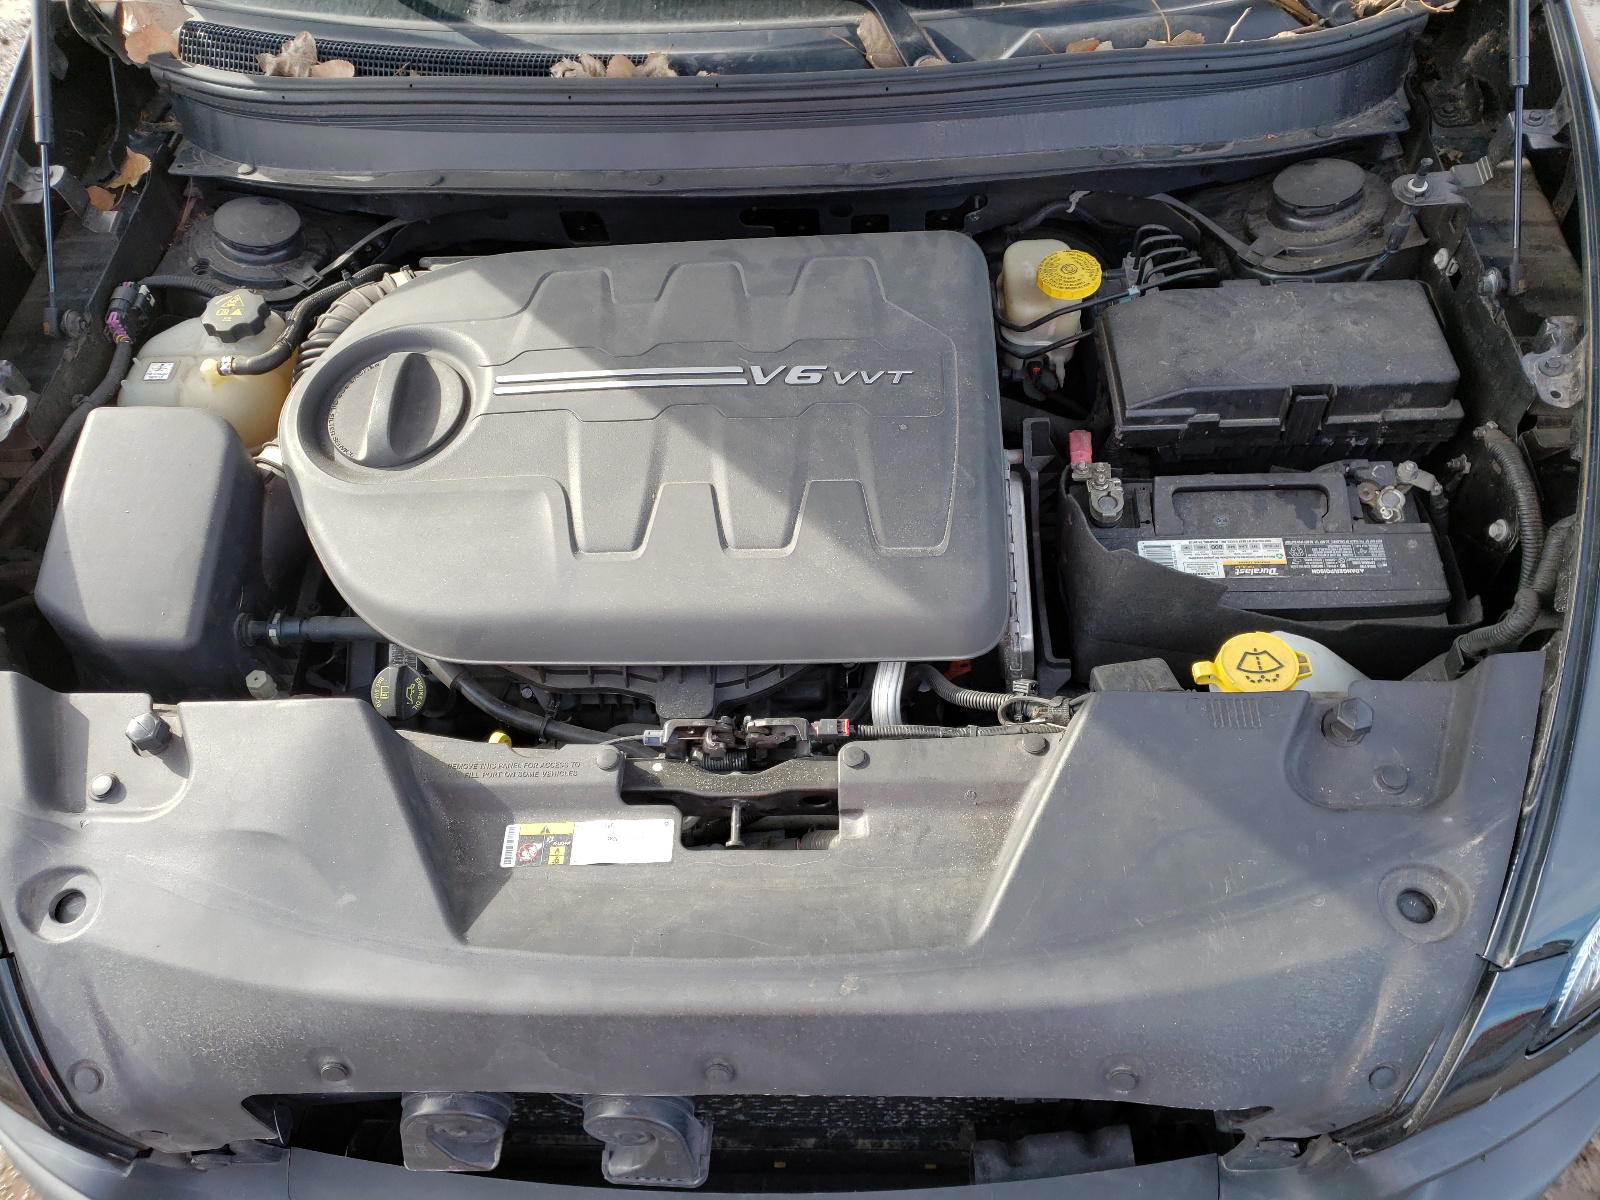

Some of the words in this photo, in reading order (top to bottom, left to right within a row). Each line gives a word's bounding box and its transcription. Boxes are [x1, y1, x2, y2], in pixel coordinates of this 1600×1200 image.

[748, 365, 829, 385] V6
[832, 370, 914, 386] VVT
[1233, 567, 1279, 576] Duralast
[414, 677, 425, 701] ENGINE
[411, 700, 422, 710] OIL
